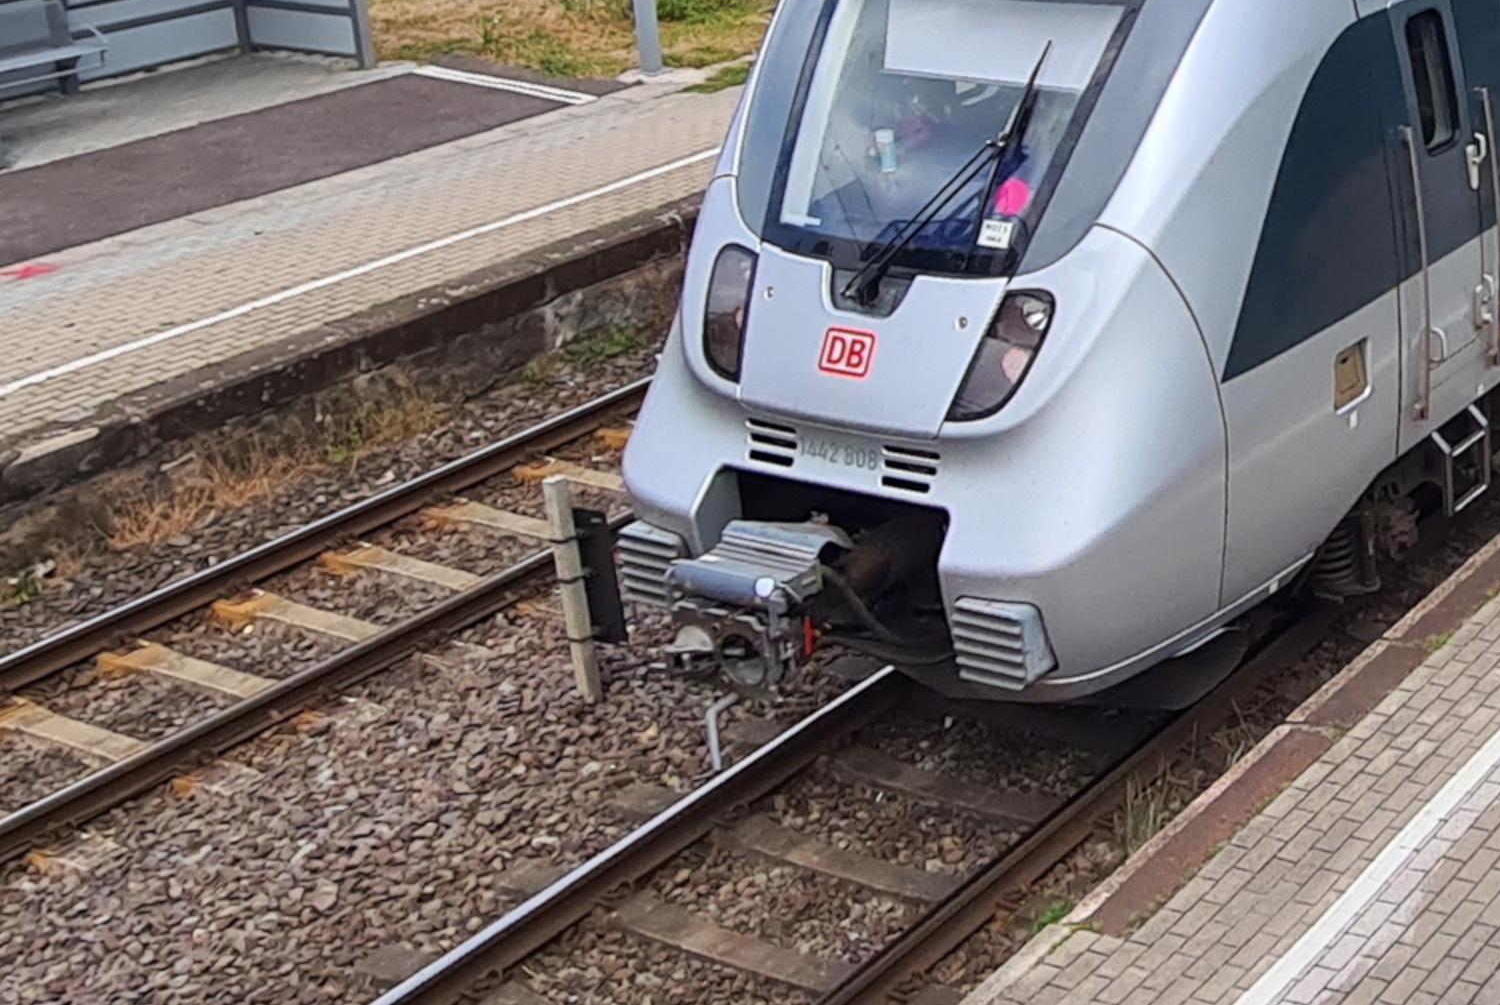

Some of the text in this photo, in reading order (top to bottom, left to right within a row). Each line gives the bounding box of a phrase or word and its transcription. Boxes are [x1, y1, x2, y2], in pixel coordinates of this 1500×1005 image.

[826, 336, 865, 368] DB
[800, 437, 878, 470] 1442 808
